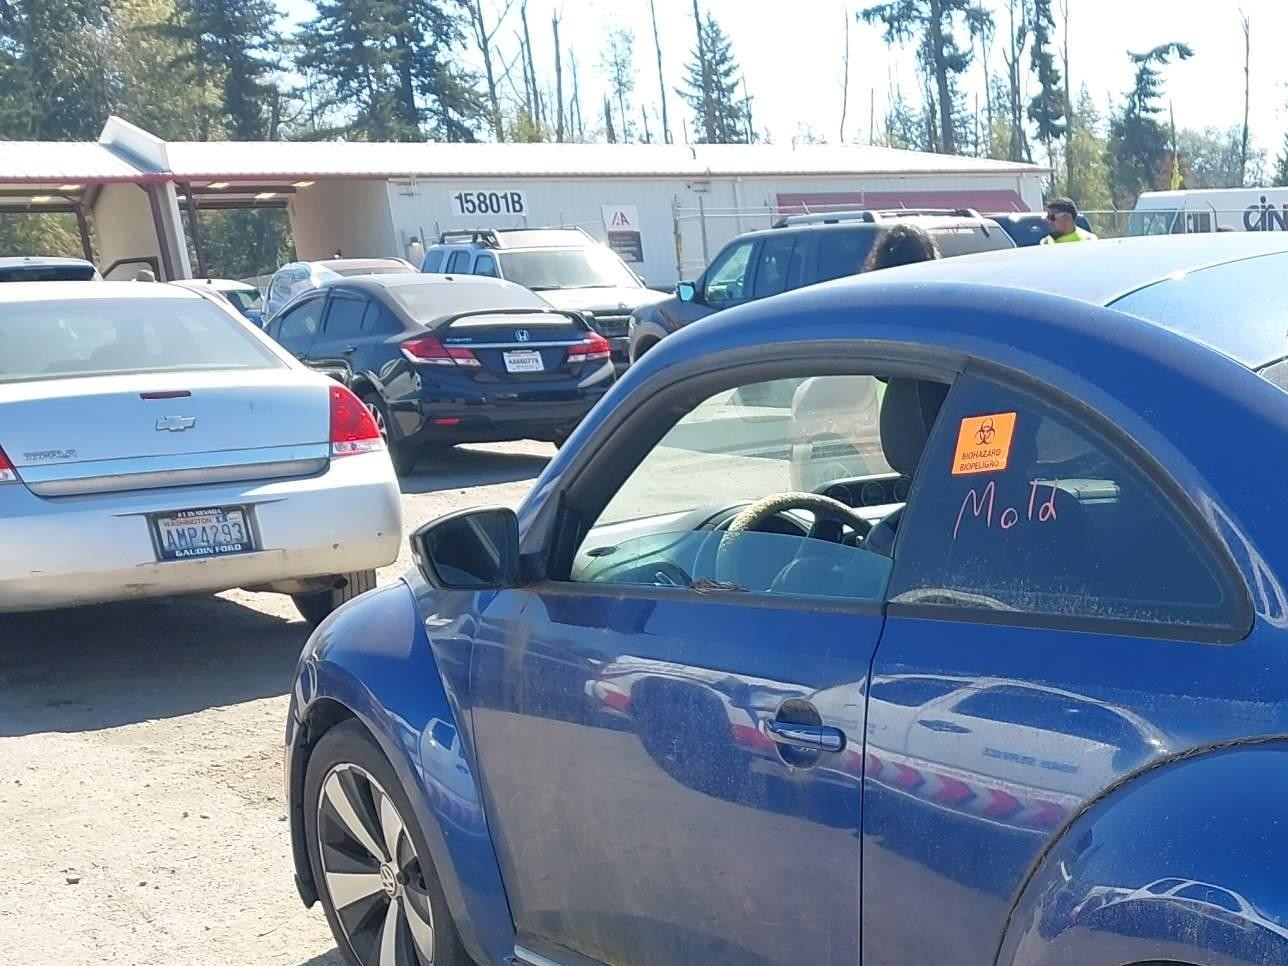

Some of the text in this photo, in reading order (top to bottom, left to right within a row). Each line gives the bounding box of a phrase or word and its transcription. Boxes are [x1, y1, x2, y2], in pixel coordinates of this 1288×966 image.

[455, 192, 524, 214] 15801B
[962, 448, 1002, 460] BIOHAZARD
[959, 460, 1000, 471] BIOPELIGRO
[166, 522, 244, 550] AMP4293
[175, 543, 242, 557] GAUDIN FORD
